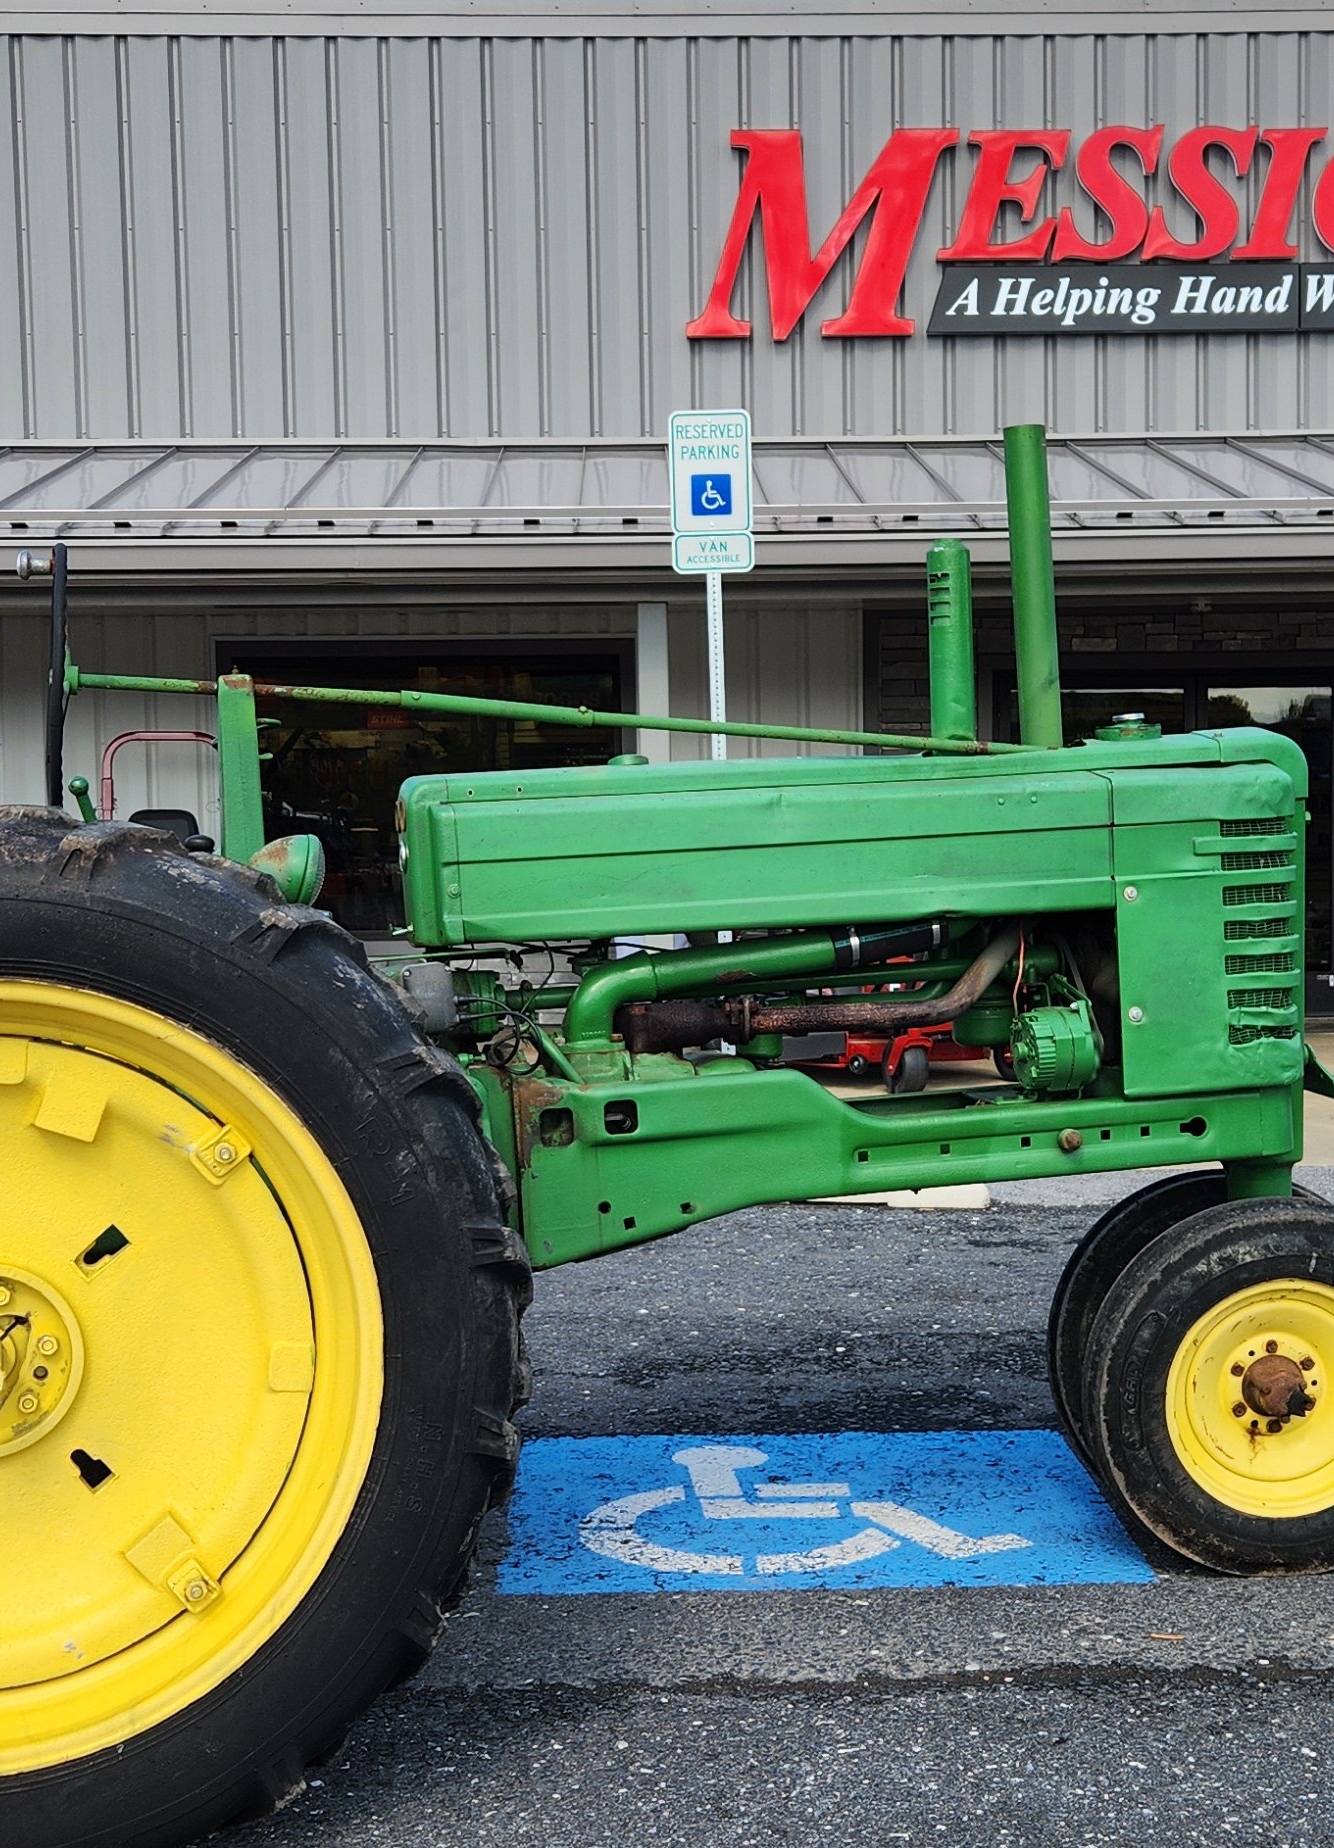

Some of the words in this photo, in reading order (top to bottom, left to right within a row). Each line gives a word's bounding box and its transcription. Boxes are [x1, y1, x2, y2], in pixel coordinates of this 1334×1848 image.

[945, 278, 981, 316] A
[989, 277, 1162, 326] Helping
[1171, 275, 1293, 314] Hand
[675, 424, 744, 440] RESERVED
[680, 445, 740, 460] PARKING
[698, 541, 728, 553] VAN
[686, 554, 741, 564] ACCESSIBLE
[370, 714, 405, 725] STIHL
